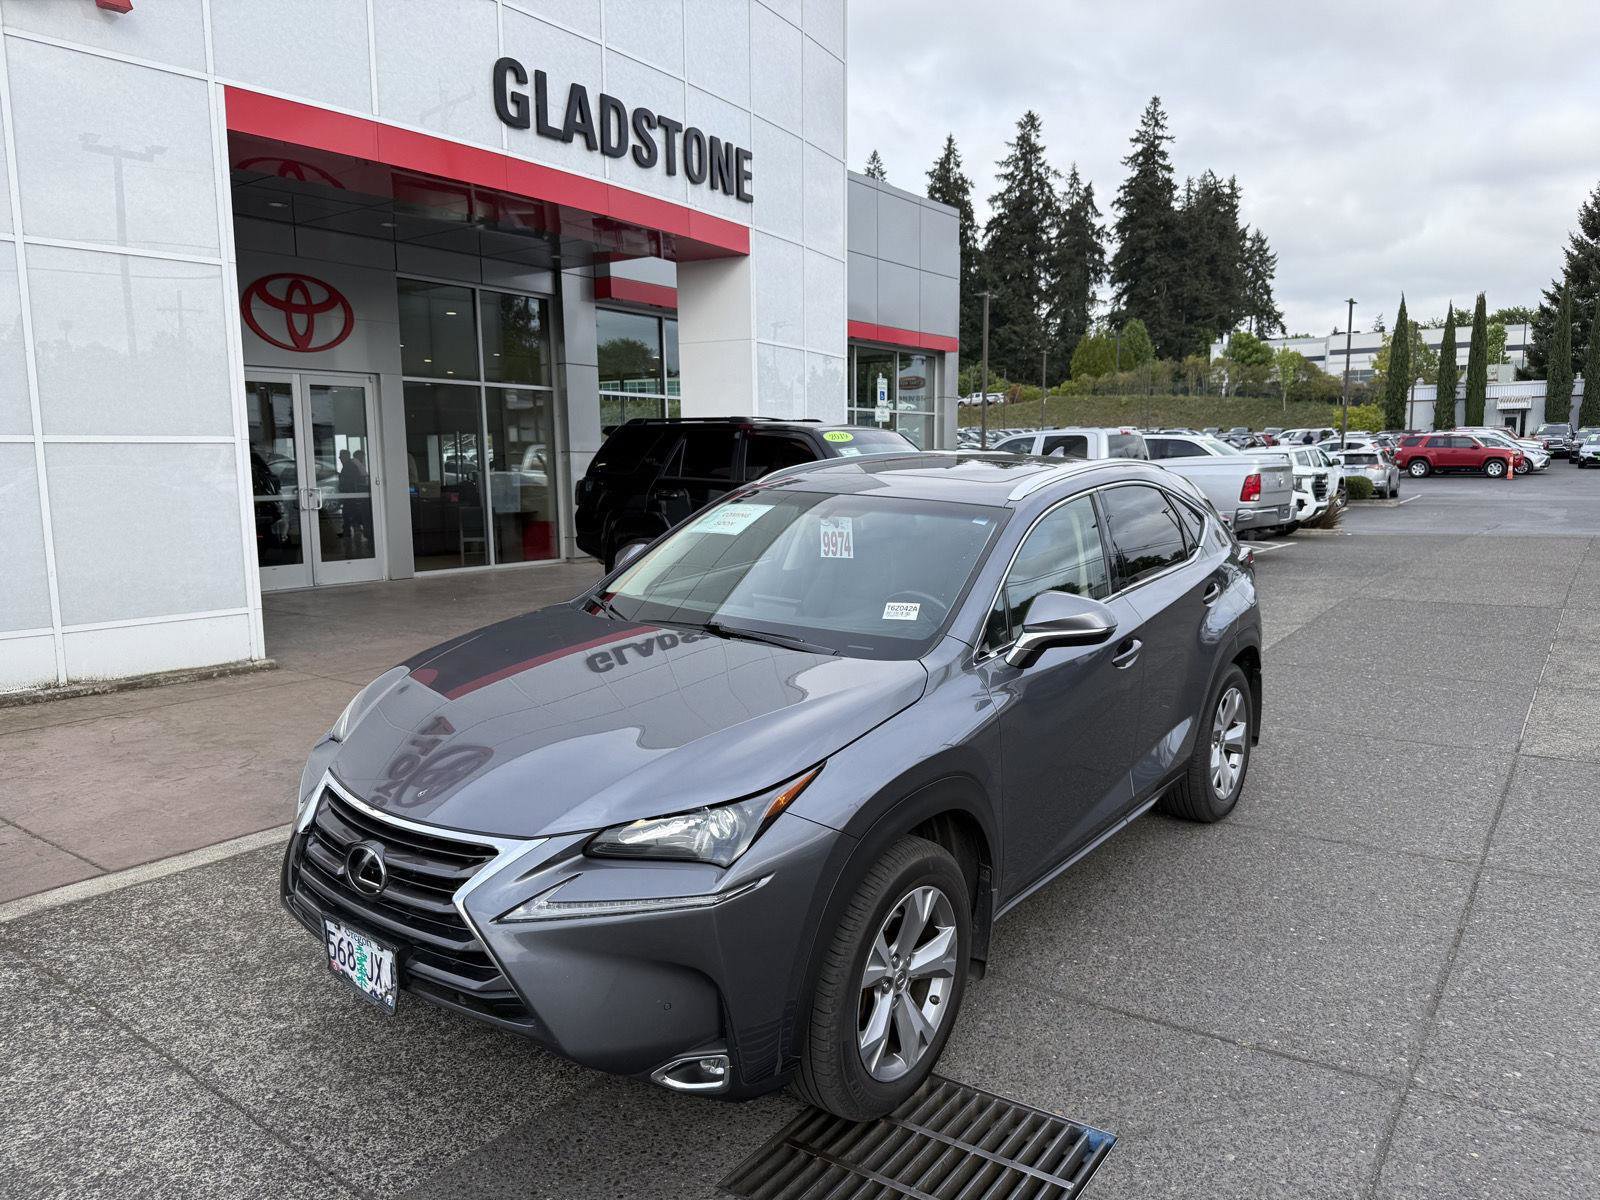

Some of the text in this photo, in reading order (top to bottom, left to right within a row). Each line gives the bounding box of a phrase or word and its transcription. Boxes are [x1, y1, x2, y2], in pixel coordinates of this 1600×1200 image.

[493, 56, 754, 203] GLADSTONE
[823, 531, 851, 557] 9974
[326, 930, 356, 972] 568
